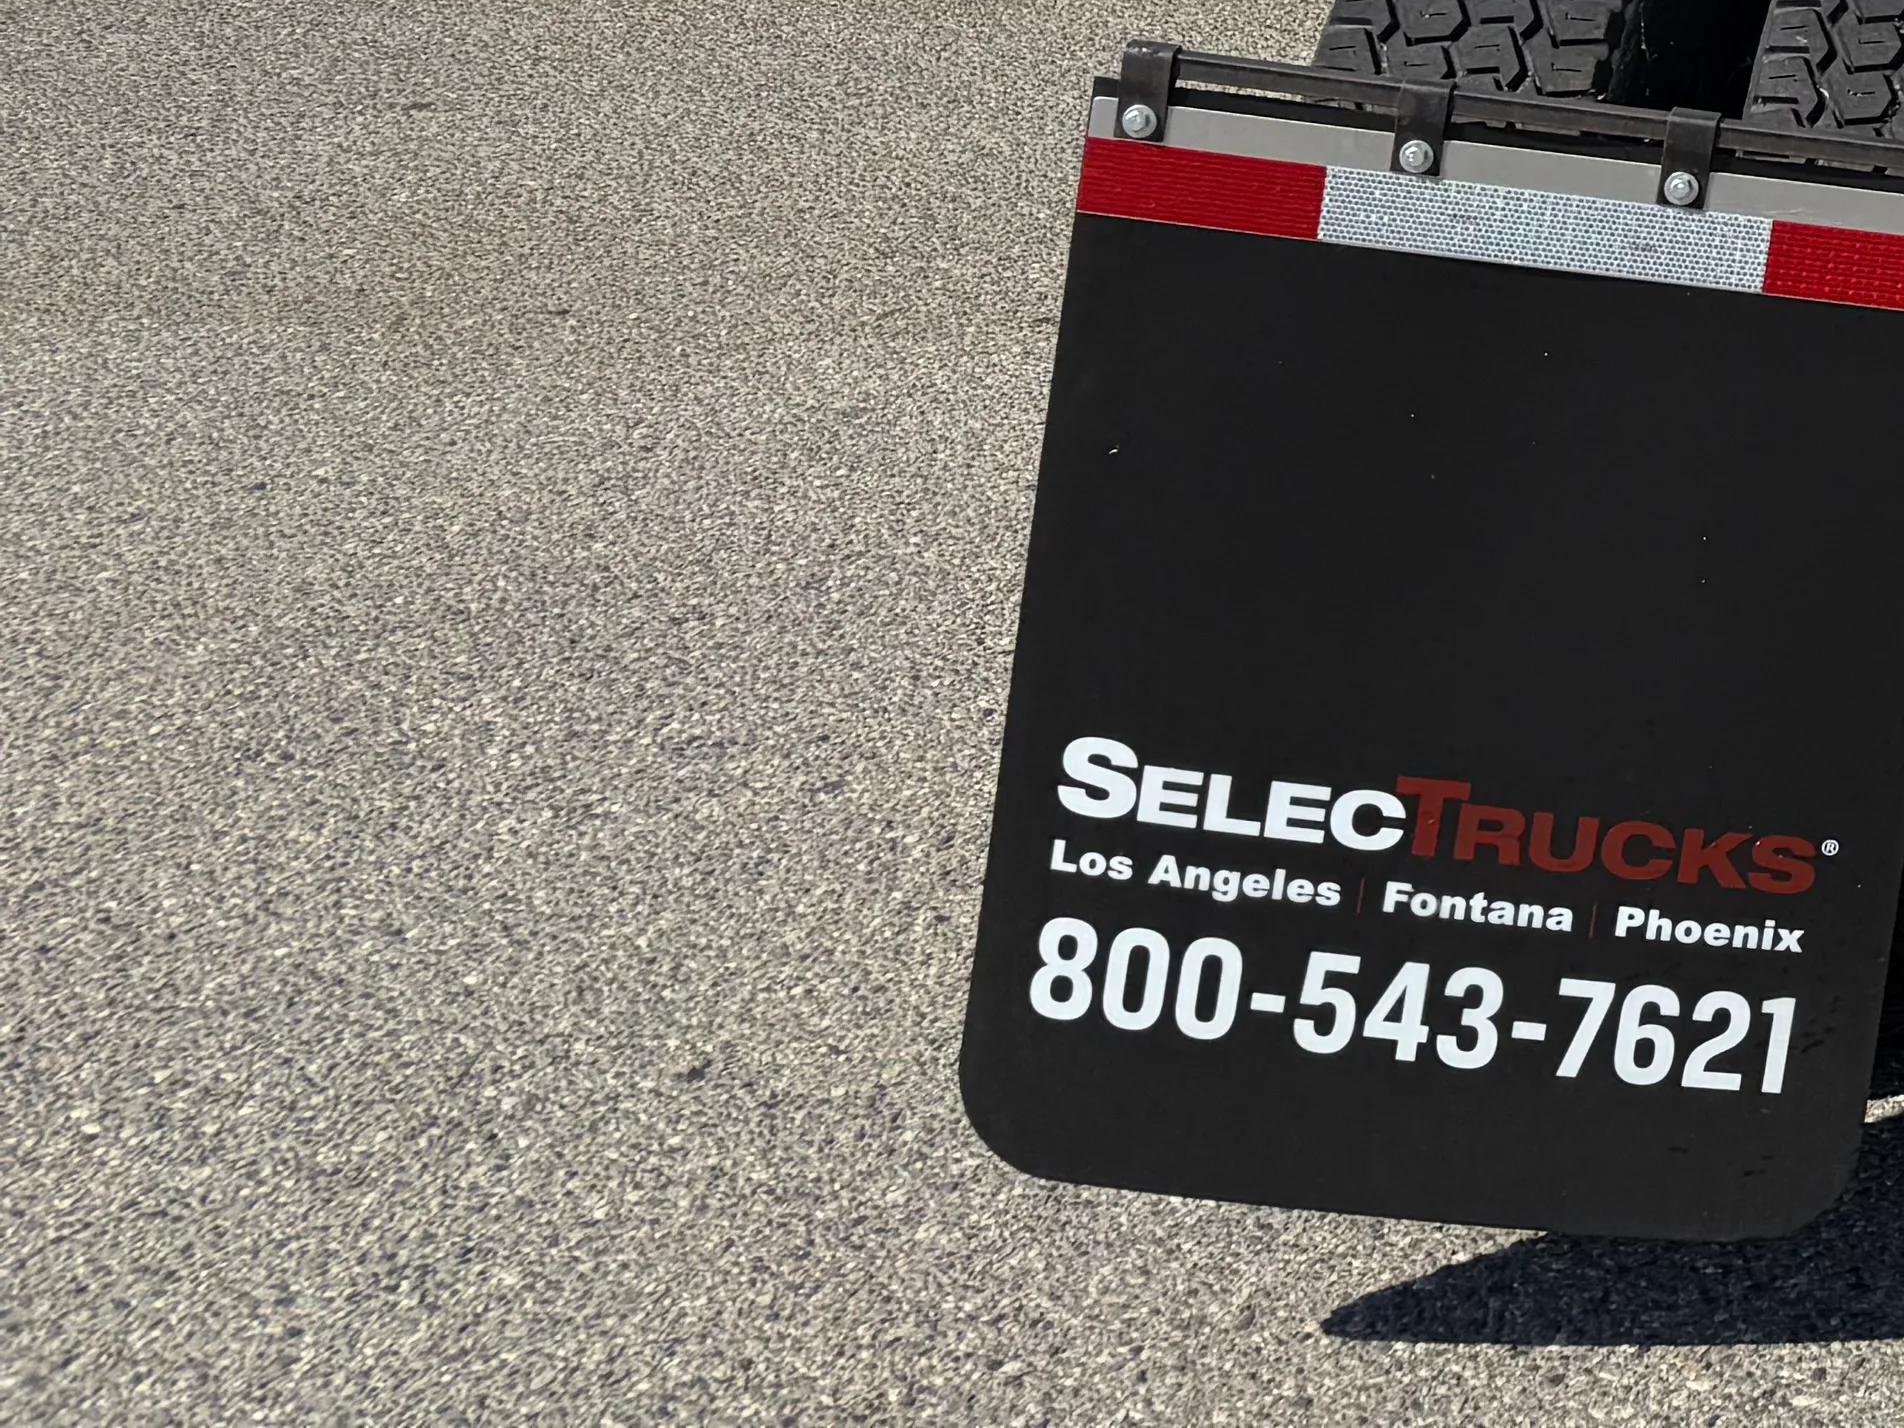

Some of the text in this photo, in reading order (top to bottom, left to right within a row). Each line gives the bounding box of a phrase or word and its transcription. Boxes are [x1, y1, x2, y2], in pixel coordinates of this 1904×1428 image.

[1050, 838, 1805, 953] Los Angeles Fontana Phoenix
[1029, 916, 1797, 1094] 800-543-7621
